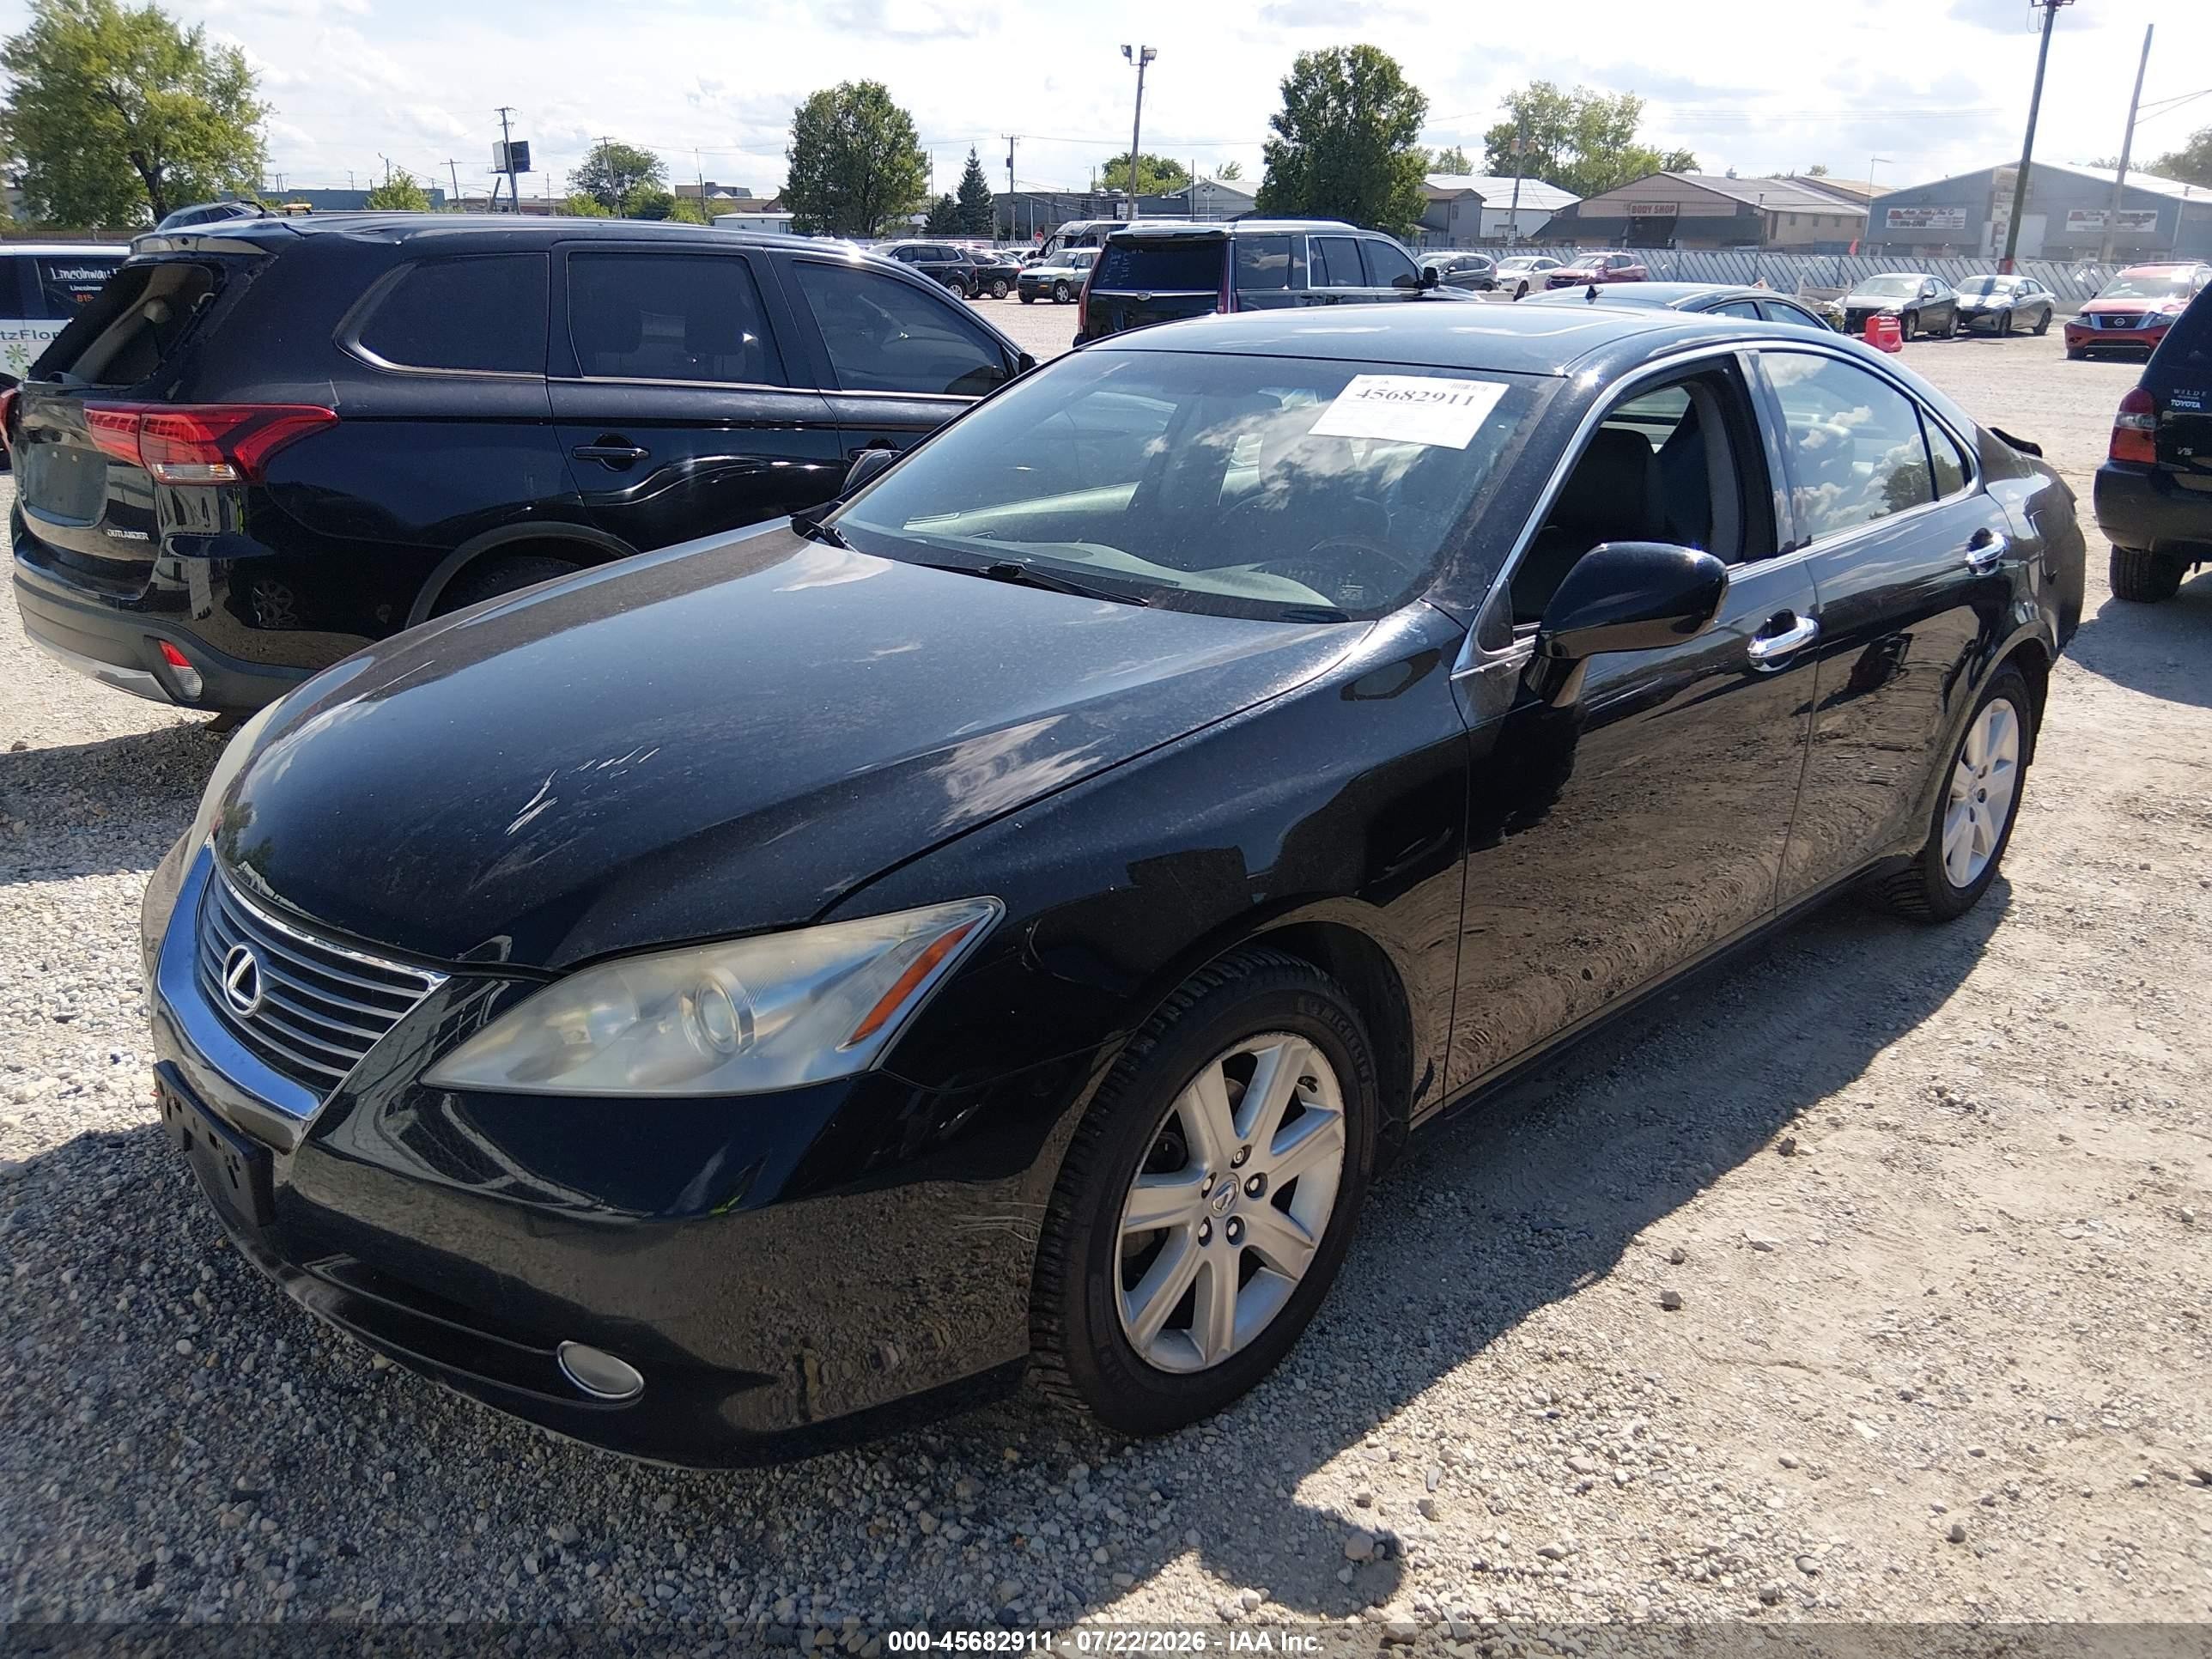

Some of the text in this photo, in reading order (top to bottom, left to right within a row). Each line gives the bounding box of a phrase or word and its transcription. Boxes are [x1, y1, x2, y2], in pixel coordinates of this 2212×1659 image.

[1632, 205, 1675, 214] BODY SHOP
[1355, 388, 1475, 406] 45682911
[2171, 399, 2201, 409] TOYOTA
[107, 529, 149, 540] OUTLANDER
